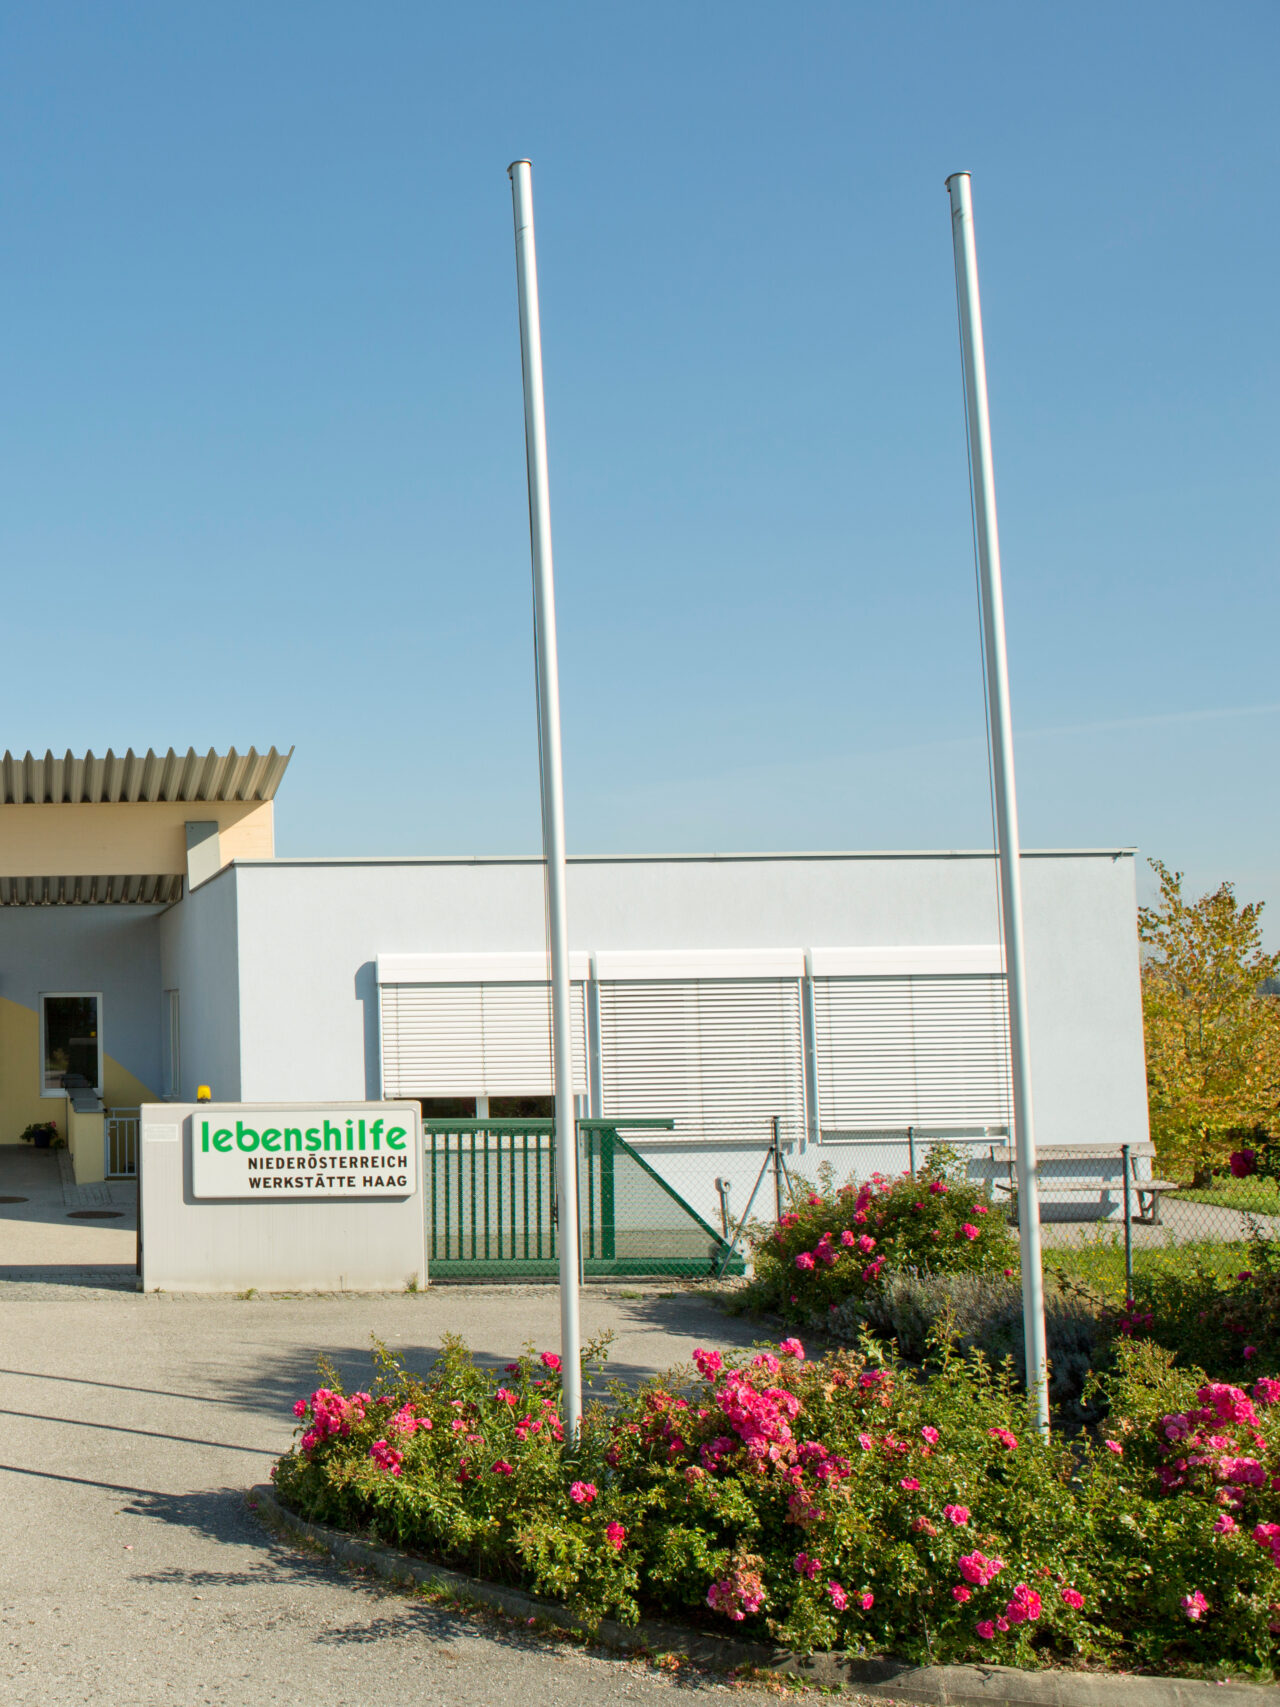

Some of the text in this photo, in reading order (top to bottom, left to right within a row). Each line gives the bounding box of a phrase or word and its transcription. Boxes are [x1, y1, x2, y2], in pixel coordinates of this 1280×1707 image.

[202, 1119, 407, 1153] lebenshilfe
[248, 1154, 407, 1169] NIEDERÖSTERREICH
[249, 1173, 407, 1188] WERKSTÄTTE HAAG
